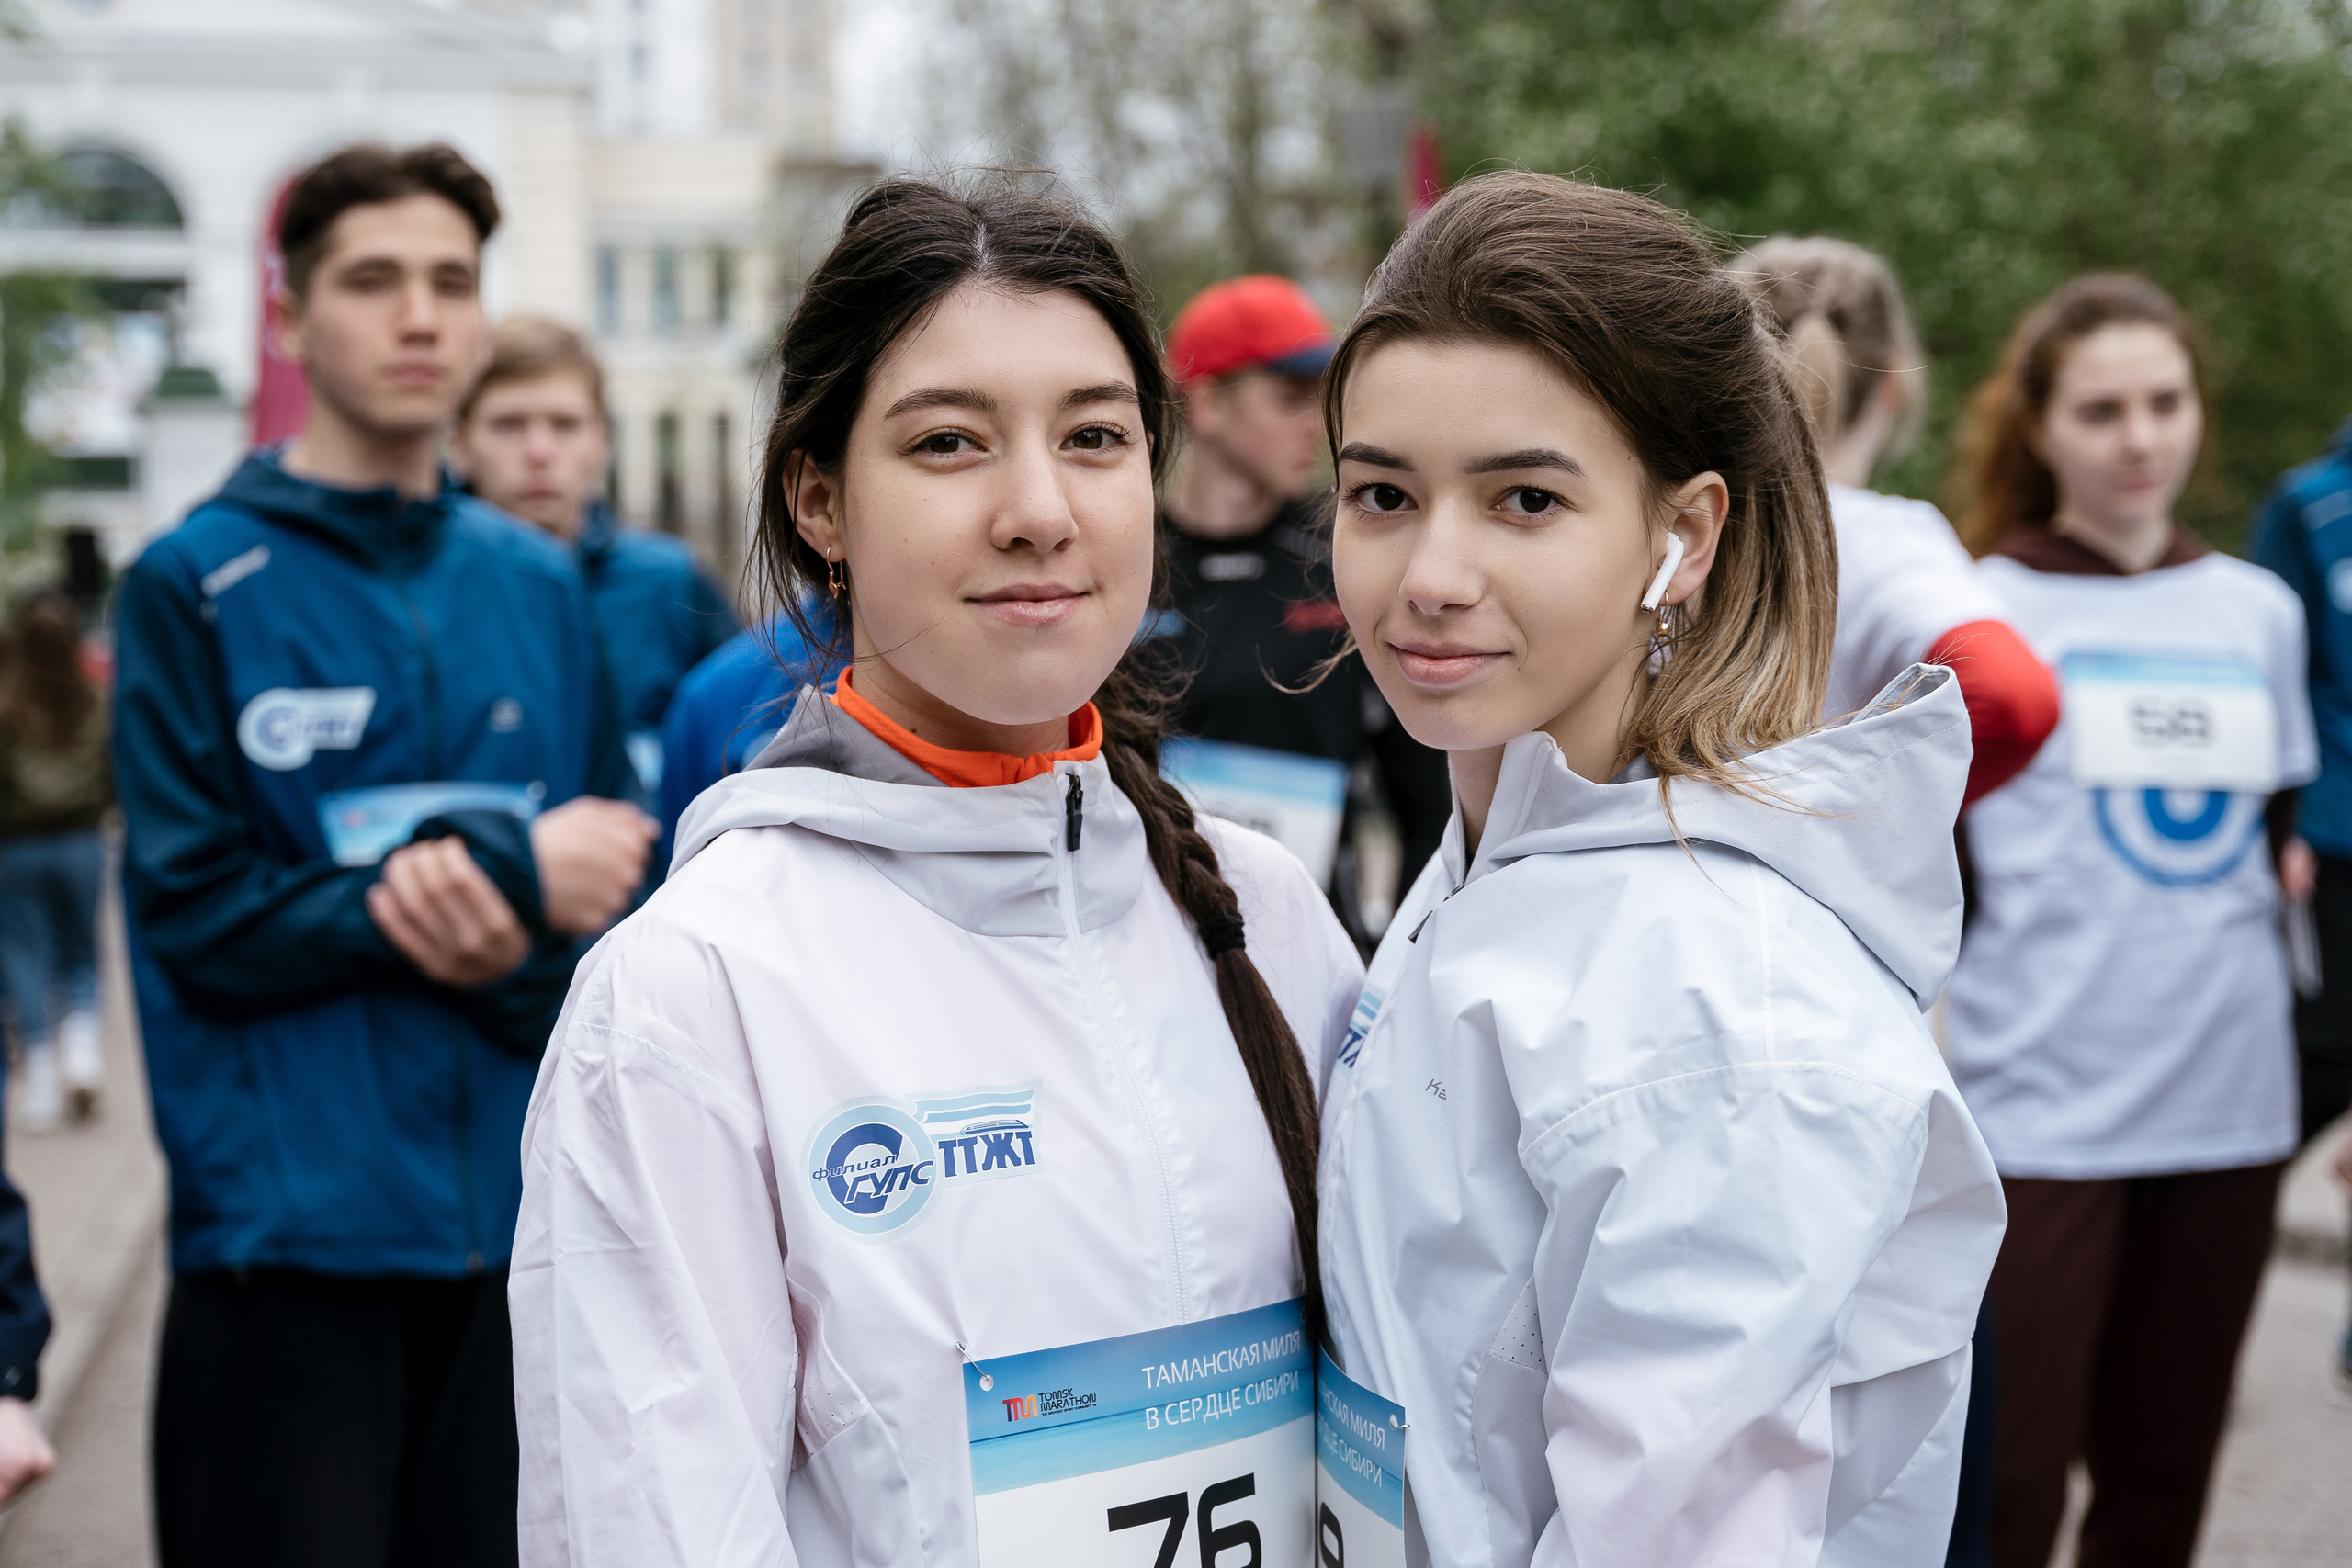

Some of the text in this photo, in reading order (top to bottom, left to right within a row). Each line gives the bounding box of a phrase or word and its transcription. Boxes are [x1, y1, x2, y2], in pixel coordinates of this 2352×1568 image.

[1425, 1078, 1447, 1100] Ka
[812, 1156, 897, 1181] филиал
[1142, 1330, 1301, 1389] ТАМАНСКАЯ МИЛЯ
[1038, 1388, 1073, 1403] TOMSK
[1040, 1393, 1097, 1412] MARATHON
[1146, 1370, 1299, 1430] В СЕРДЦЕ СИБИРИ
[1351, 1410, 1385, 1451] МИЛЯ
[1339, 1438, 1382, 1488] СИБИРИ
[1107, 1472, 1262, 1568] 76
